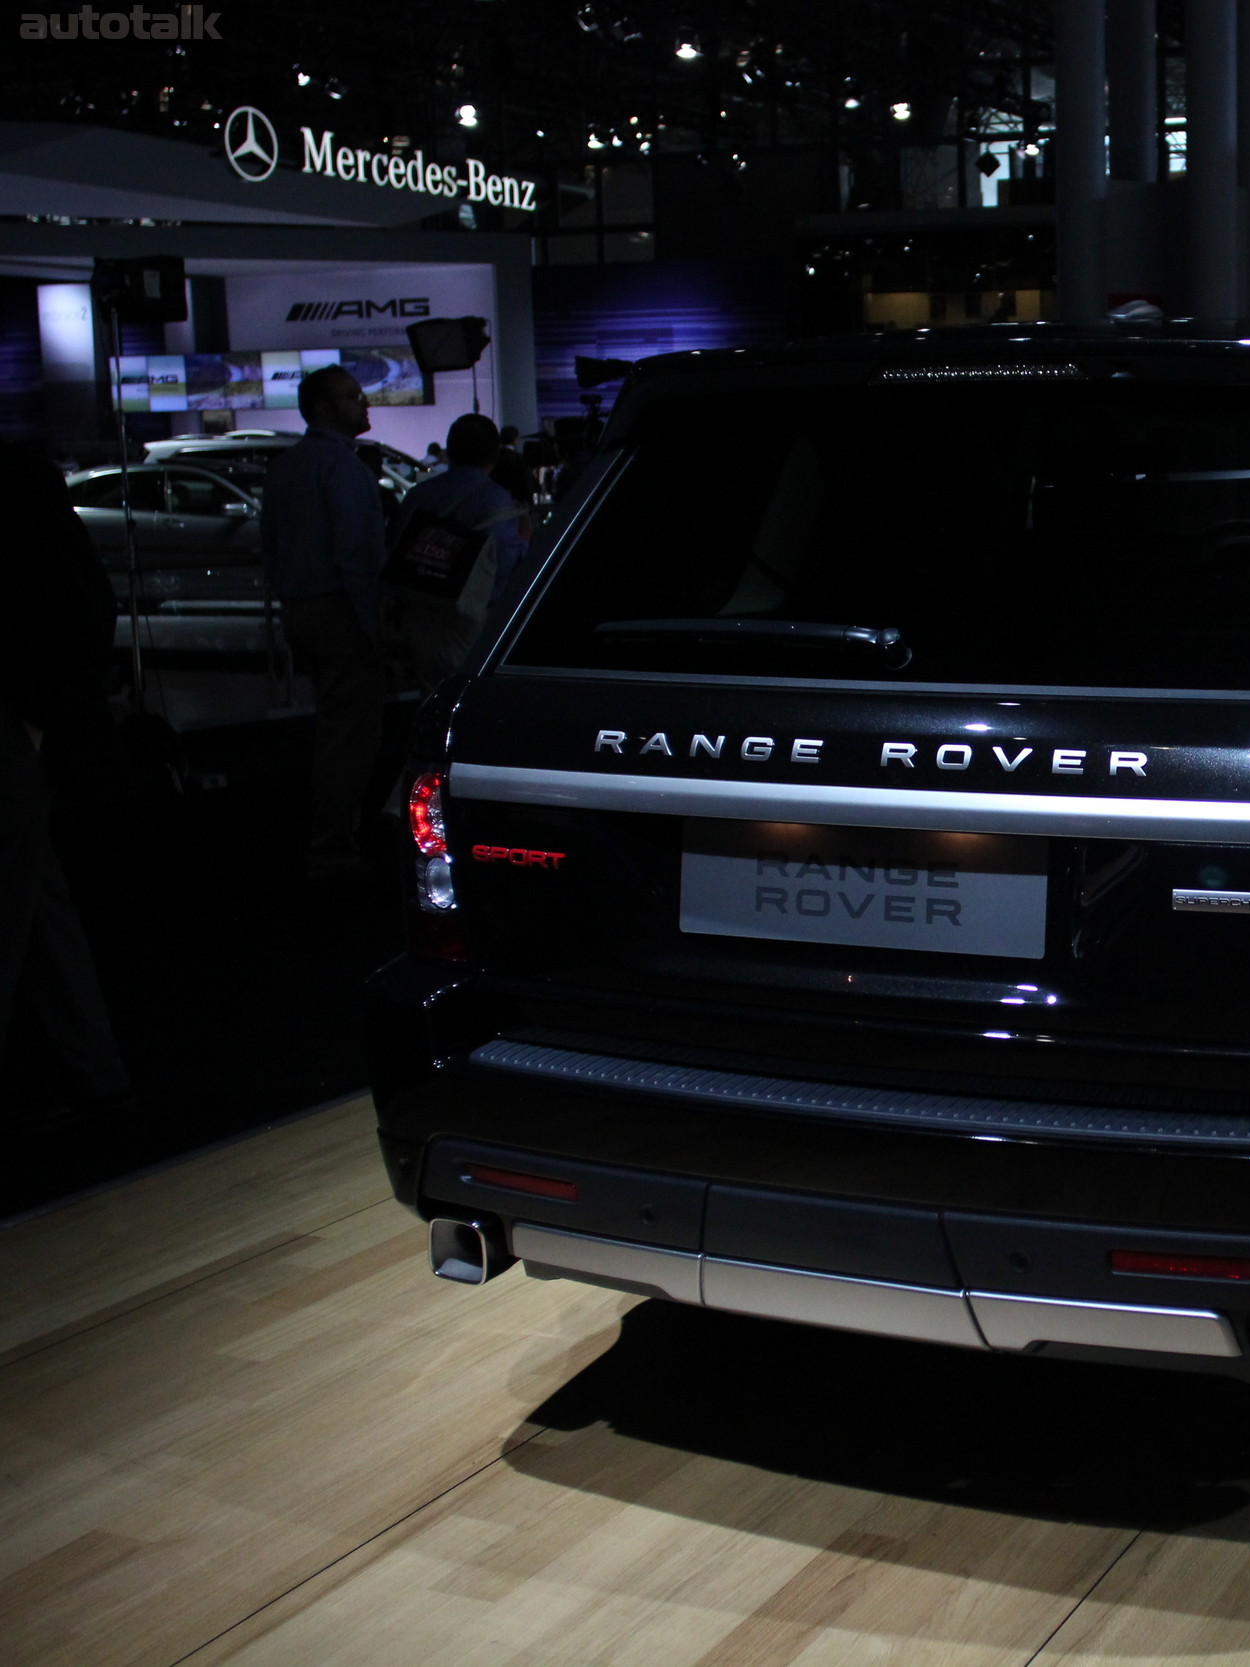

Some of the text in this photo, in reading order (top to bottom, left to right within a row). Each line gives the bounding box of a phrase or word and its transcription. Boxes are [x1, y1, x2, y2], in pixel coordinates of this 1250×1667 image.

[300, 126, 537, 211] Mercedes-Benz
[332, 298, 430, 320] AMG
[593, 728, 1149, 778] RANGE ROVER
[471, 844, 568, 870] SPORT
[756, 850, 960, 888] RANGE
[755, 886, 962, 927] ROVER
